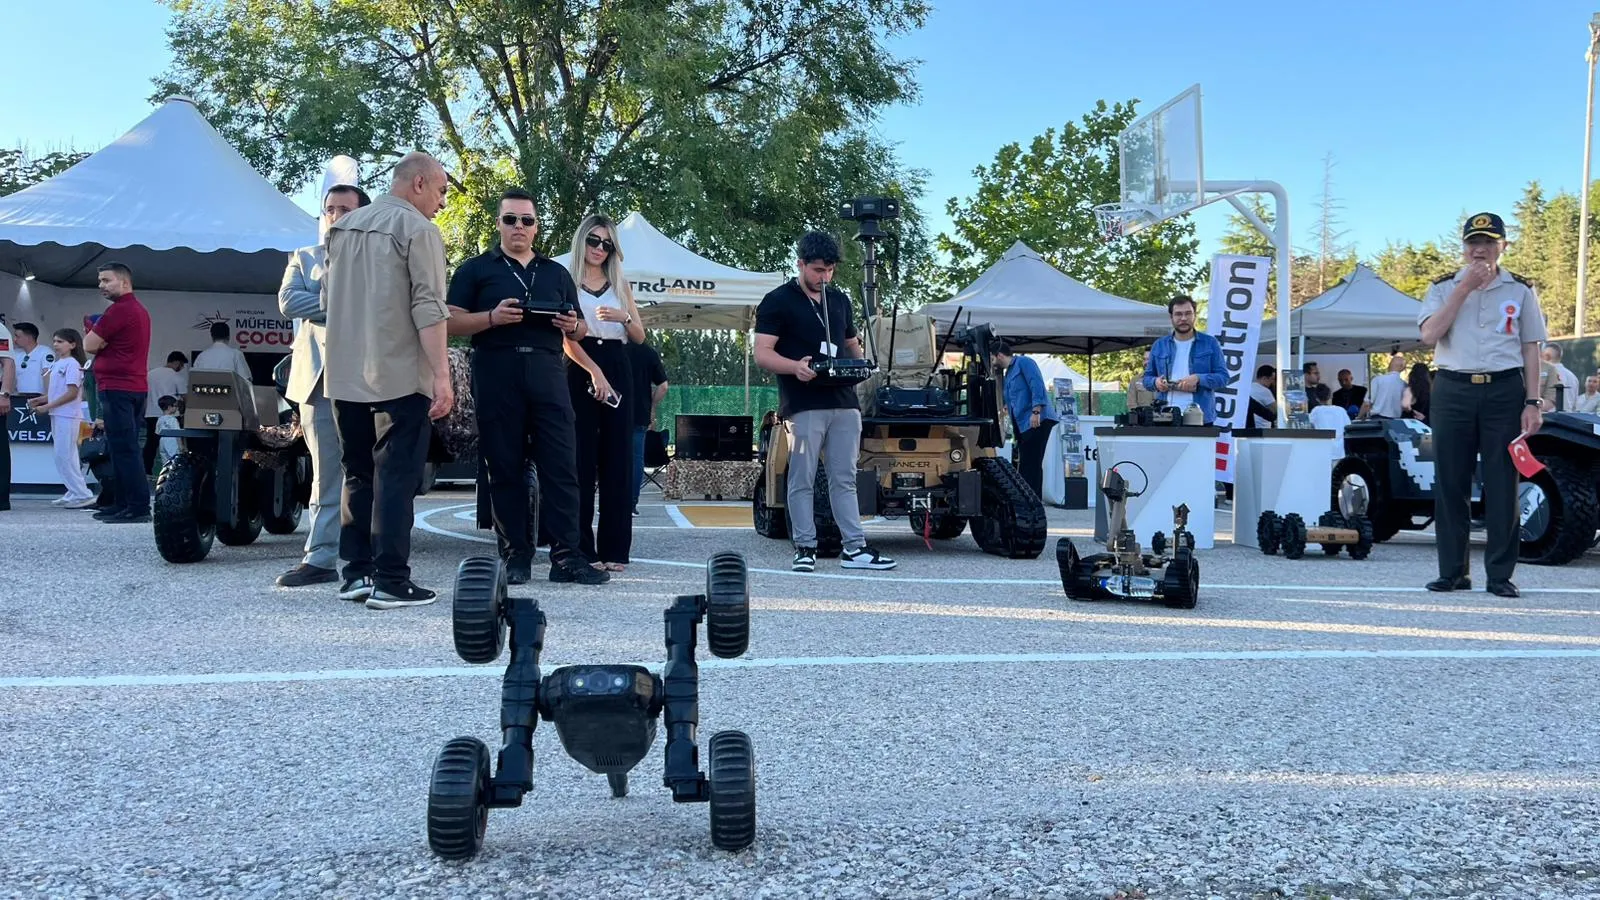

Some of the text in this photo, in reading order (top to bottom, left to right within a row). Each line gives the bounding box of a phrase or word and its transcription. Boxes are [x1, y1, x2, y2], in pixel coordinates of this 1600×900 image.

[667, 288, 717, 296] DEFENCE
[236, 317, 294, 330] MÜHEND
[236, 330, 294, 349] ÇOCU
